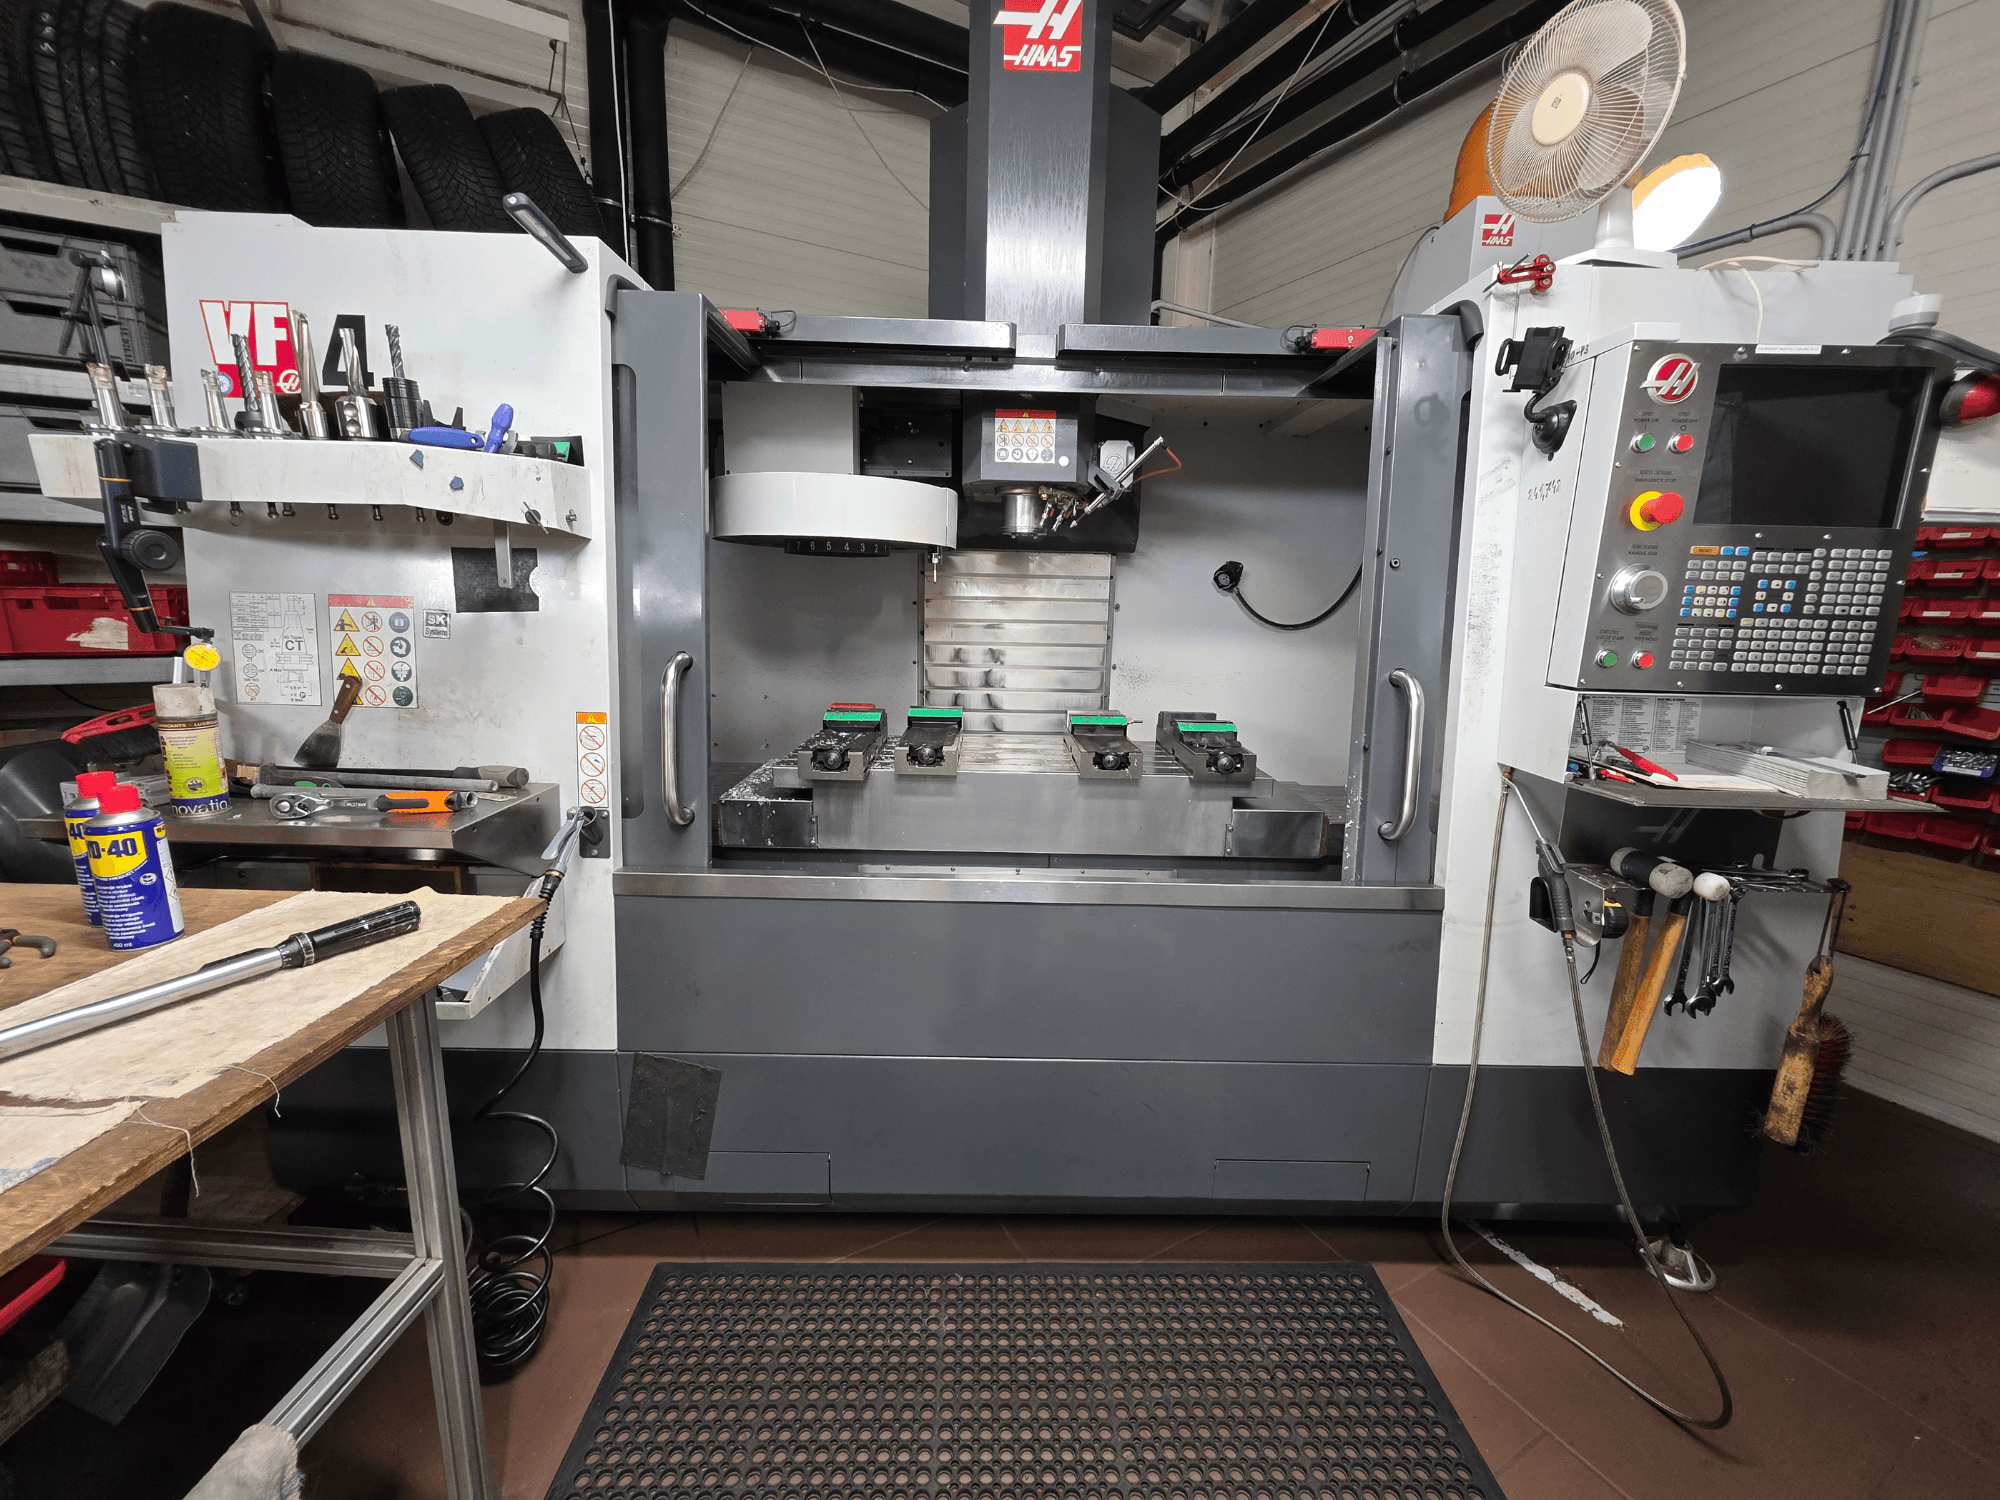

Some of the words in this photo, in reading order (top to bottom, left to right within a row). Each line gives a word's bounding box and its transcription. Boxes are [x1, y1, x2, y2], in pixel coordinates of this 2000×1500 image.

[1004, 44, 1081, 67] HAAS
[1482, 236, 1513, 245] HAAS
[200, 301, 288, 366] VF
[796, 542, 800, 550] 7
[810, 541, 815, 550] 6
[826, 541, 832, 550] 5
[844, 542, 850, 551] 4
[860, 543, 865, 552] 3
[874, 544, 878, 553] 2
[428, 615, 446, 625] SK
[285, 640, 303, 651] CT
